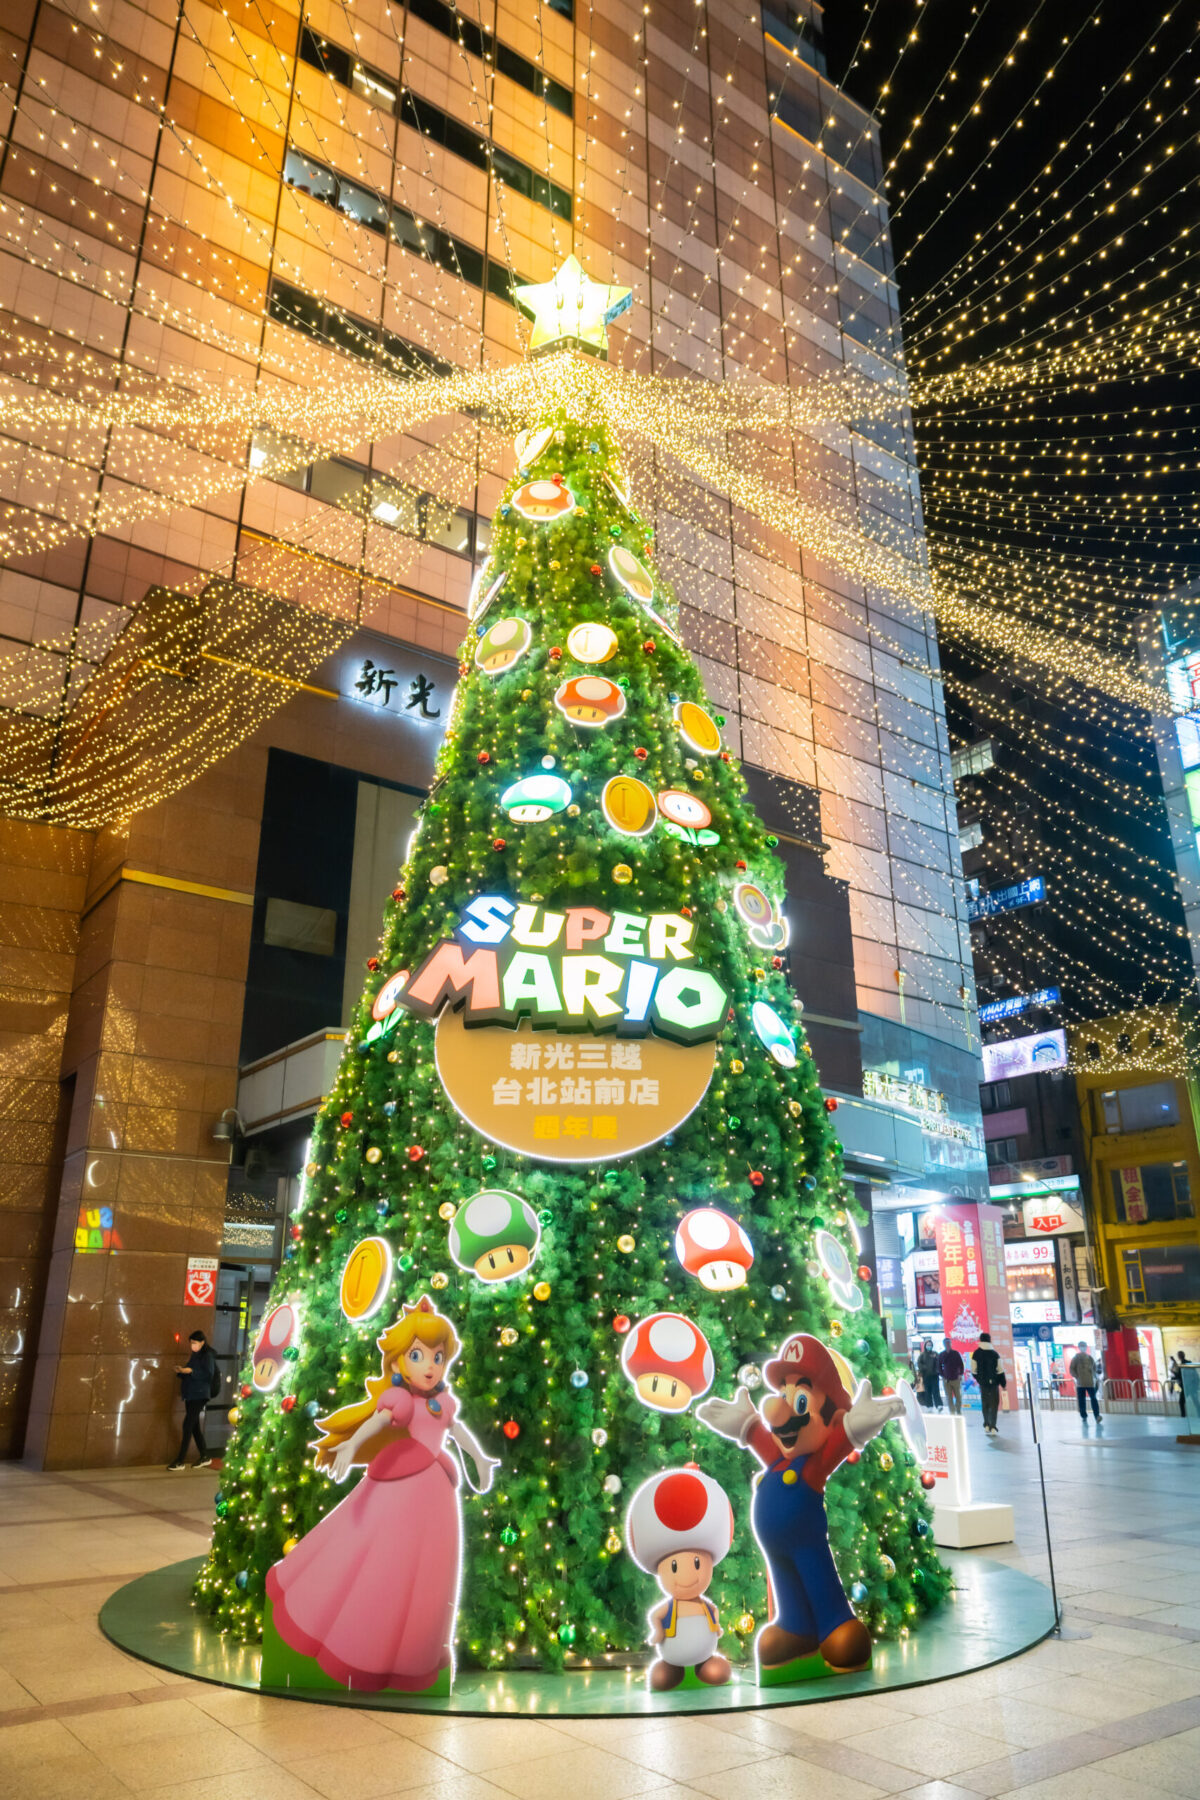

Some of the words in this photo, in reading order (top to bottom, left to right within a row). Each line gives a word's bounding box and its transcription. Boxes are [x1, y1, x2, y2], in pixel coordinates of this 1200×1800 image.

[354, 659, 441, 719] 新光
[459, 896, 695, 961] SUPER
[407, 942, 728, 1029] MARIO
[509, 1043, 642, 1071] 新光三越
[491, 1077, 660, 1106] 台北站前店
[533, 1115, 618, 1140] 週年慶
[1037, 1216, 1060, 1229] 入口
[941, 1220, 965, 1288] 週年慶
[784, 1344, 801, 1363] M
